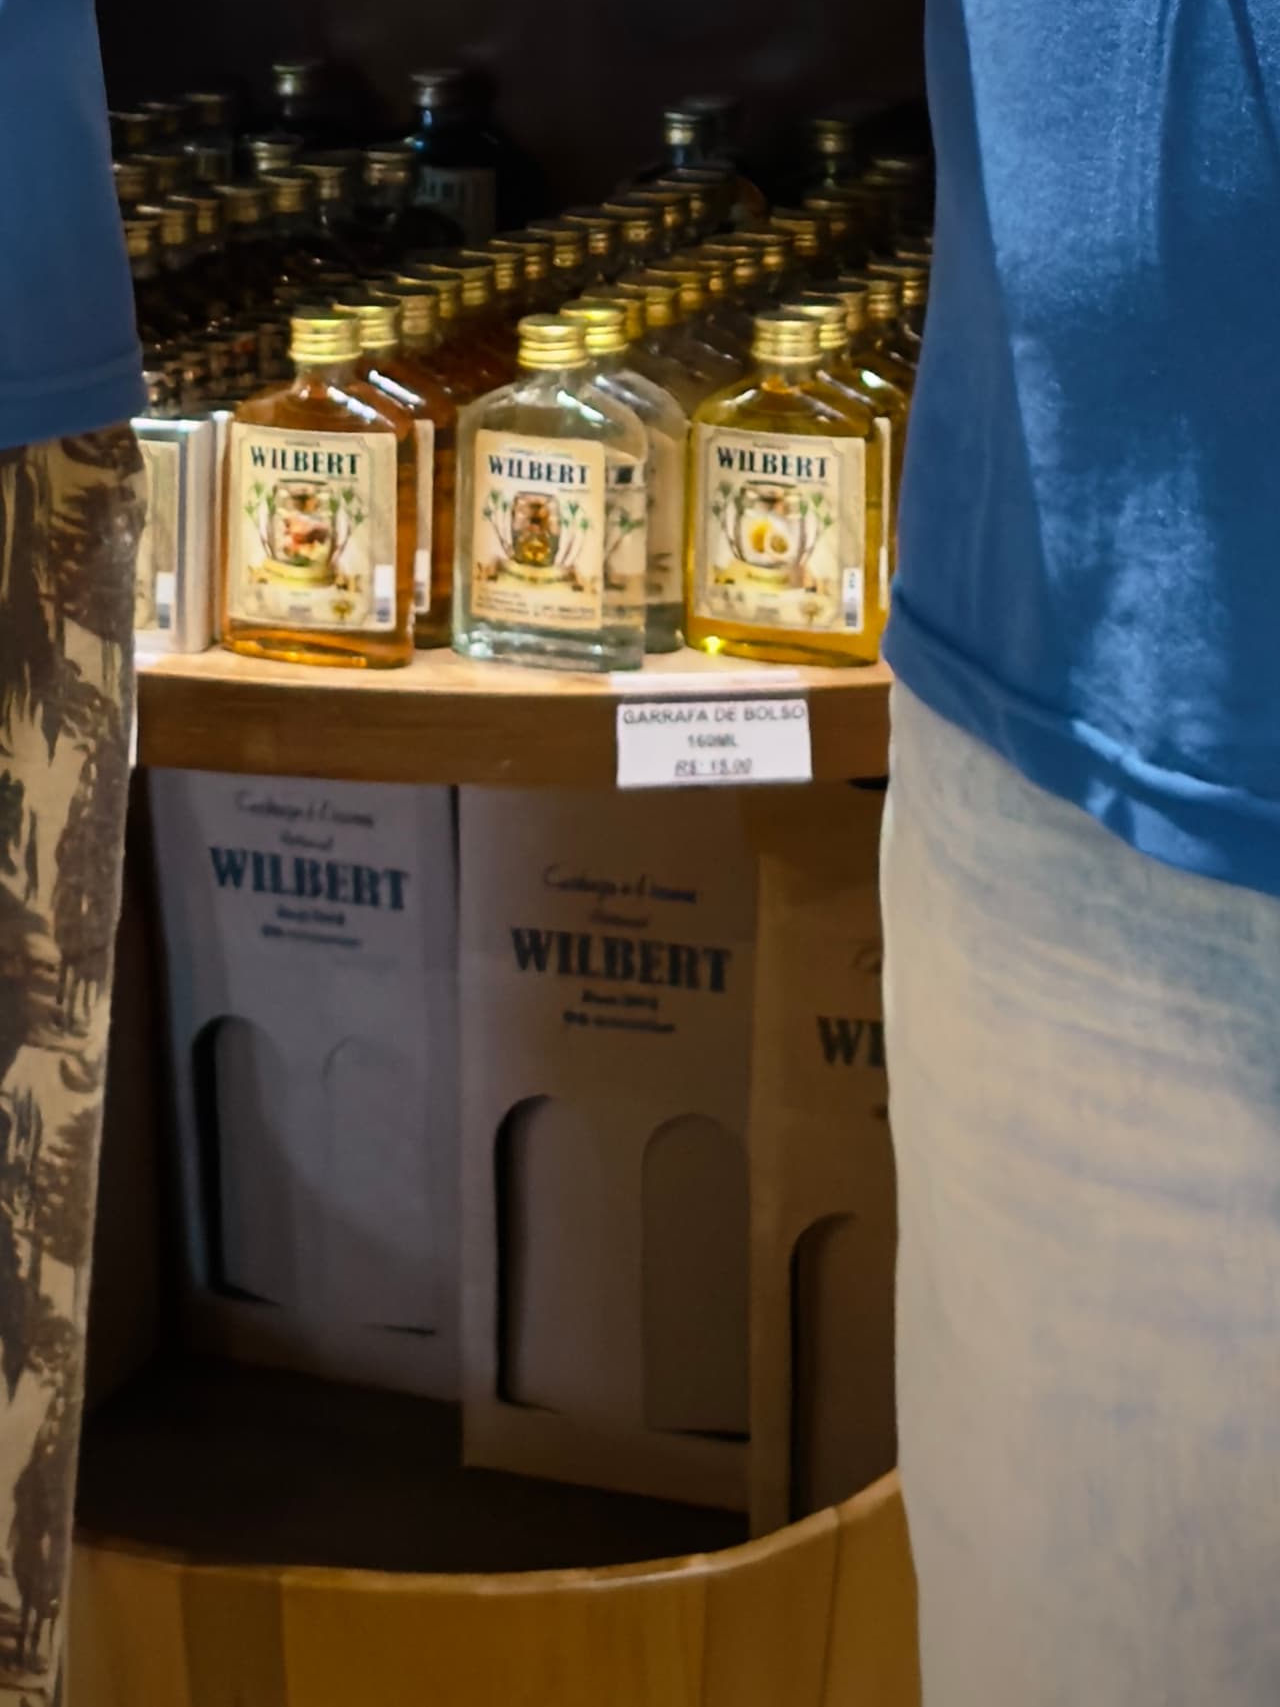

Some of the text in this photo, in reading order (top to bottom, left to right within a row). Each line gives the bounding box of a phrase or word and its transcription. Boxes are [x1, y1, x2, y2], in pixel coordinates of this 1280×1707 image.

[250, 445, 361, 475] WILBERT
[488, 454, 591, 484] WILBERT
[717, 446, 830, 479] WILBERT
[623, 704, 805, 724] GARRAFA DE BOLSO
[209, 846, 410, 911] WILBERT
[511, 927, 733, 992] WILBERT
